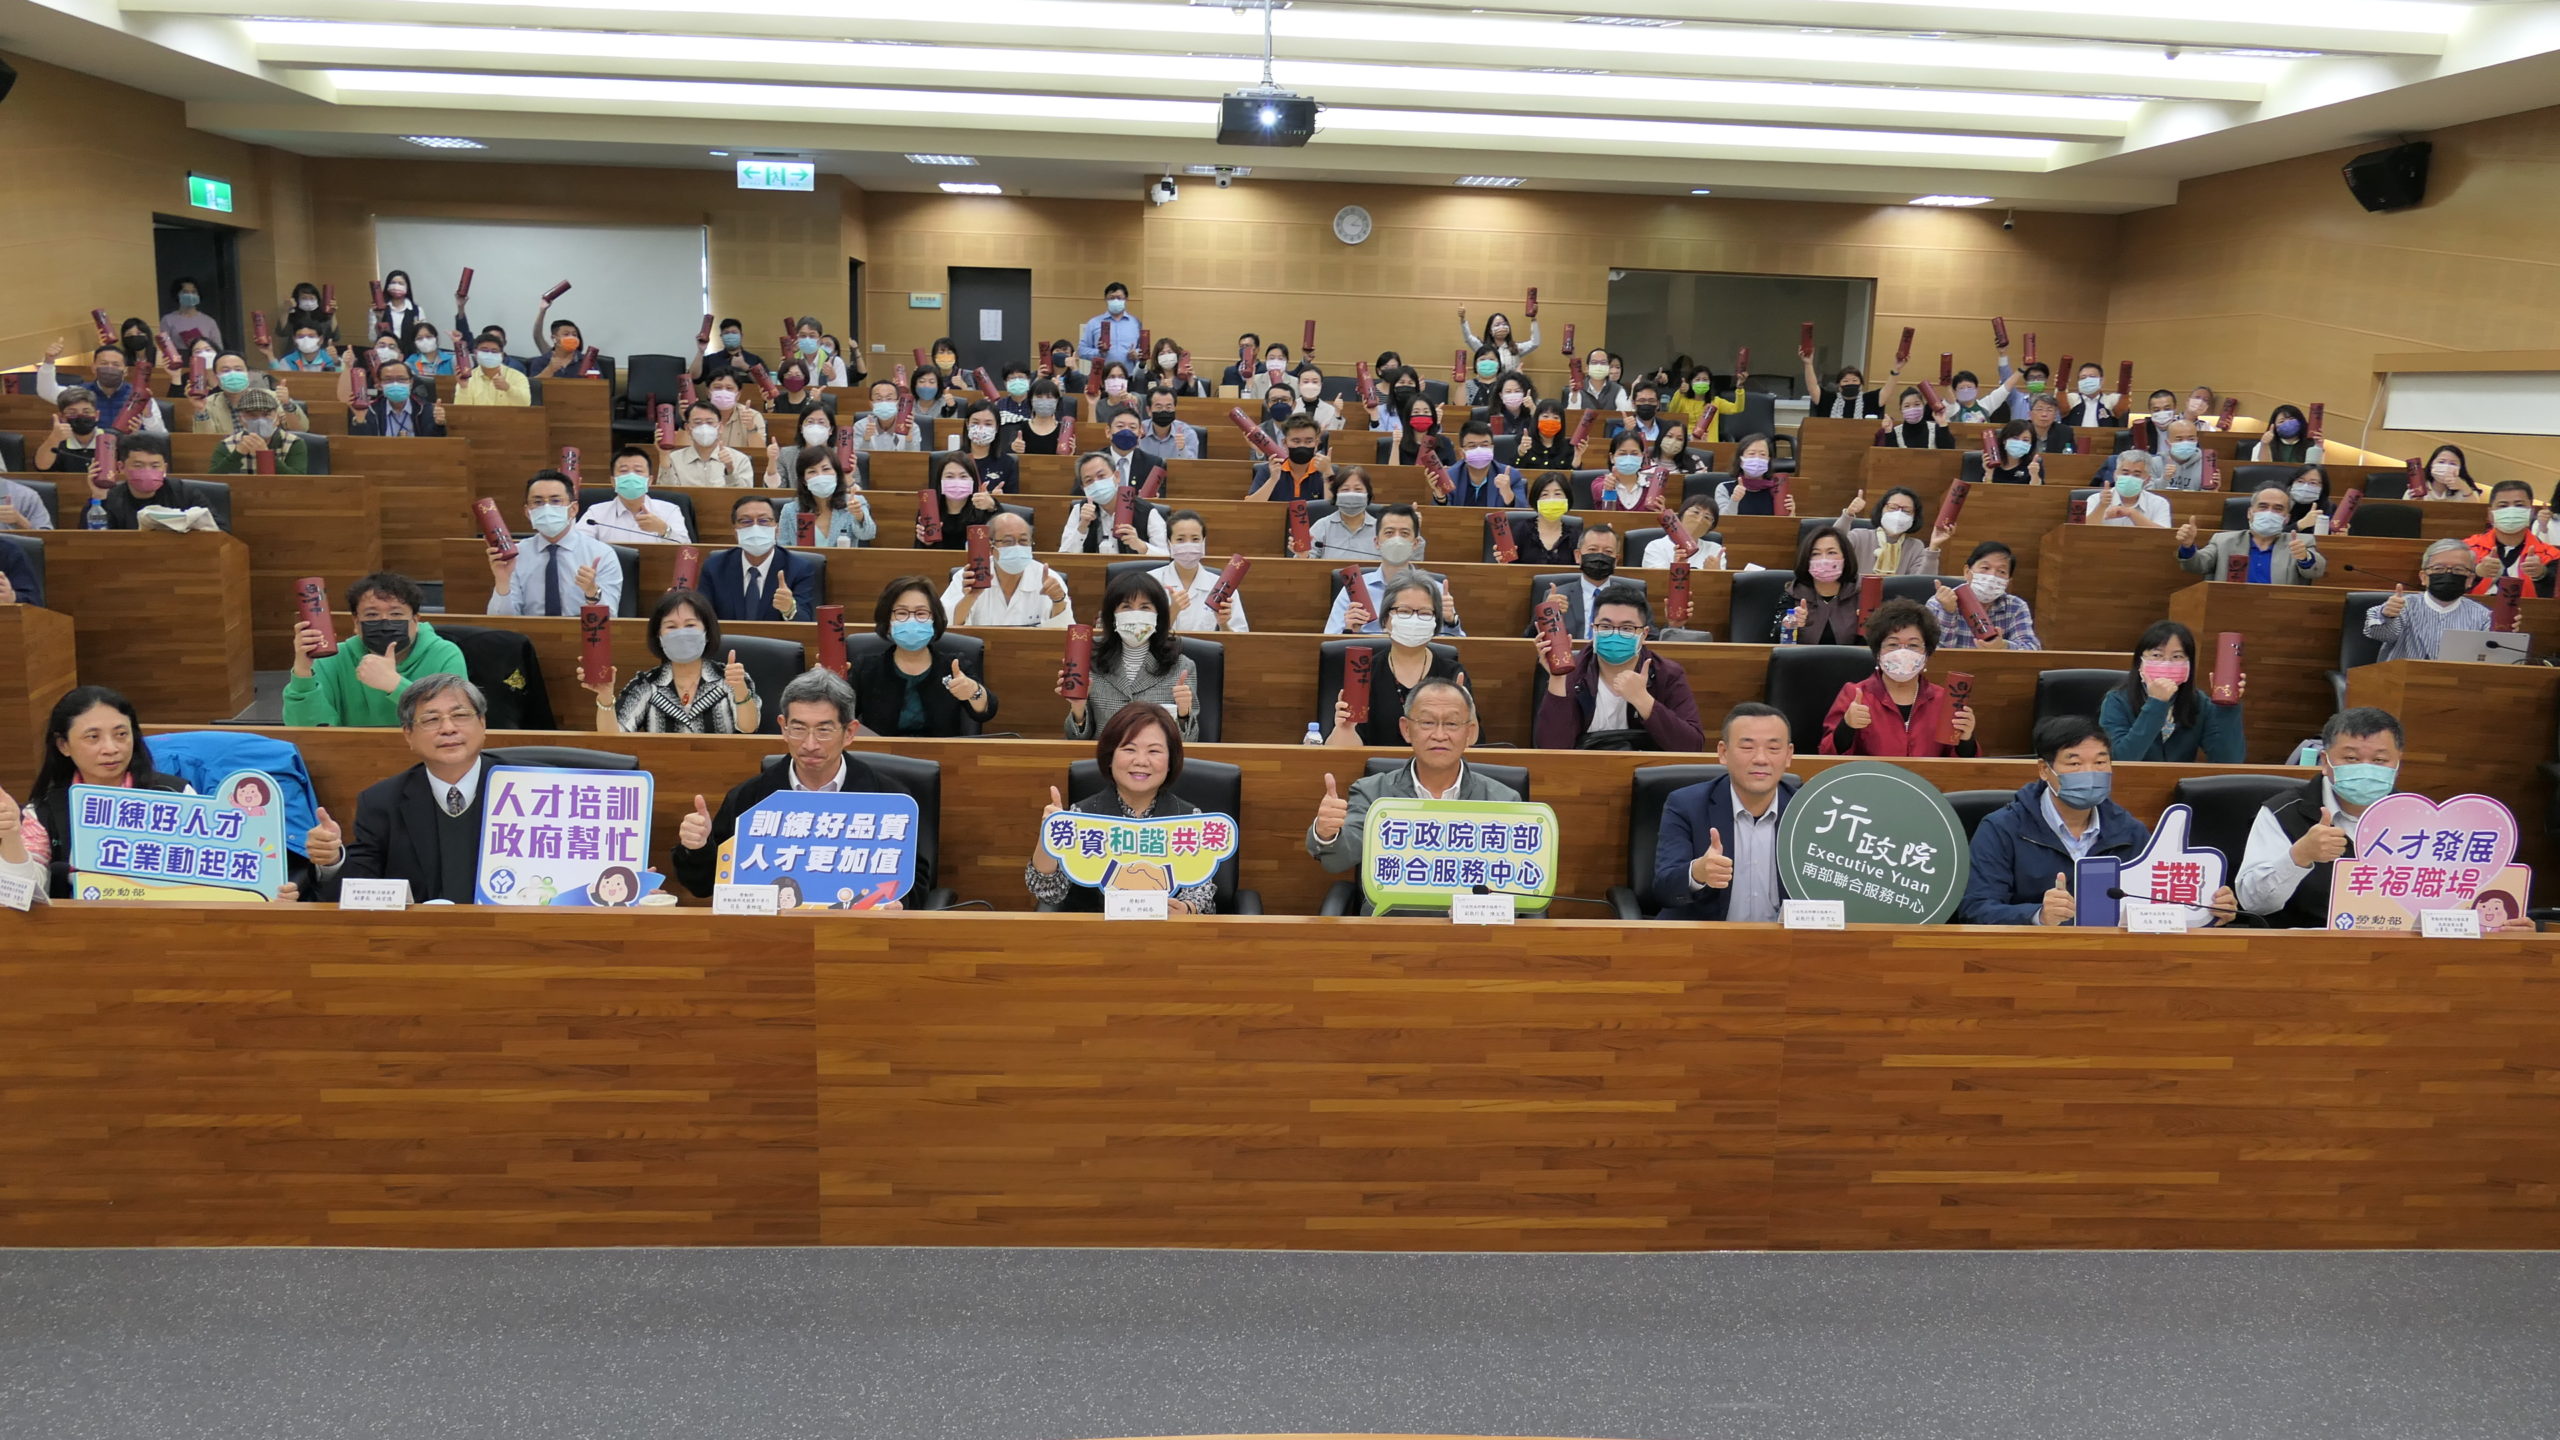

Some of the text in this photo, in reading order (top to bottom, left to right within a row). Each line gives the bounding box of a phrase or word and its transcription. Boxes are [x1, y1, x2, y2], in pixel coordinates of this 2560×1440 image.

[84, 796, 244, 839] 訓練好人才
[491, 782, 640, 821] 人才培訓
[489, 822, 639, 862] 政府幫忙
[749, 809, 910, 841] 訓練好品質
[1050, 820, 1228, 856] 勞資和諧共榮
[1381, 819, 1540, 851] 行政院南部
[1815, 795, 1938, 874] 行政院
[99, 838, 260, 881] 企業動起來
[739, 843, 902, 875] 人才更加值
[2363, 827, 2499, 863] 人才發展
[1376, 856, 1542, 886] 聯合服務中心
[1802, 862, 1925, 914] 南部聯合服務中心
[1807, 842, 1931, 915] Executive Yuan
[2347, 864, 2481, 900] 幸福職場
[102, 886, 146, 897] 勞動部
[2355, 914, 2403, 926] 勞動部
